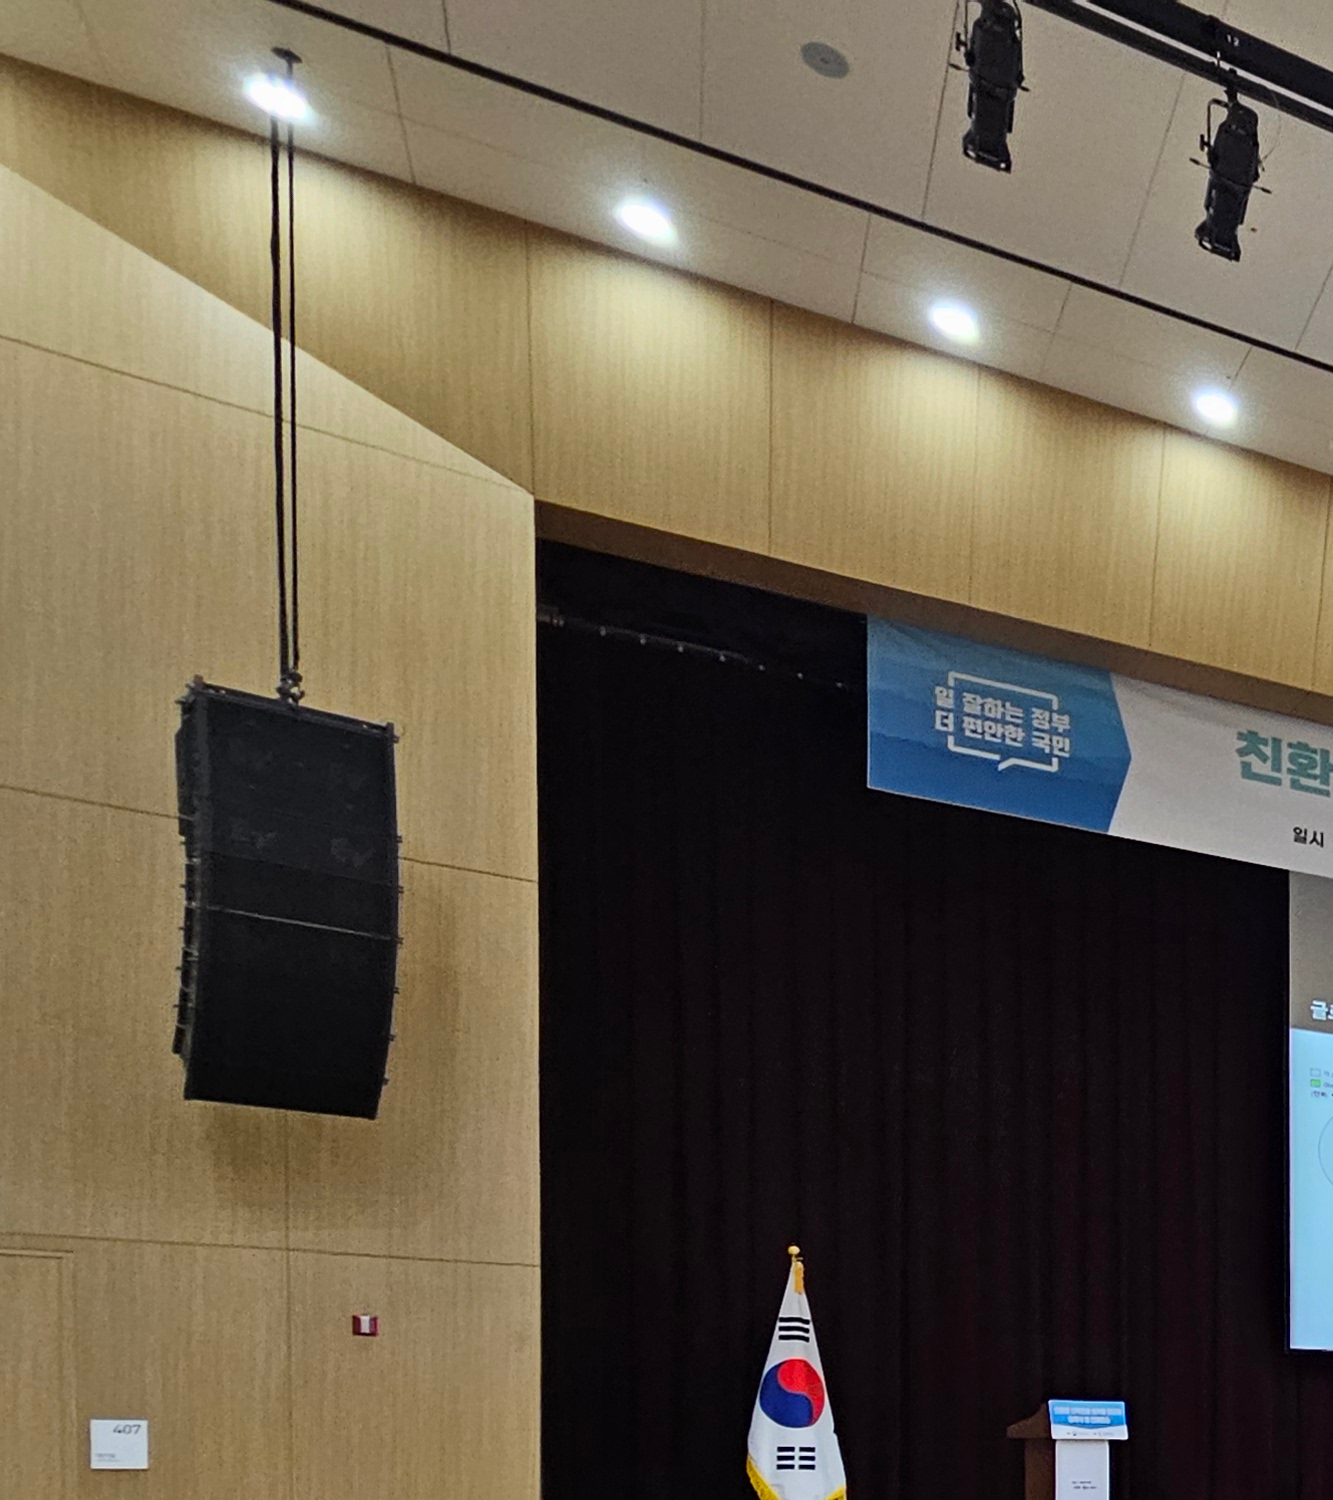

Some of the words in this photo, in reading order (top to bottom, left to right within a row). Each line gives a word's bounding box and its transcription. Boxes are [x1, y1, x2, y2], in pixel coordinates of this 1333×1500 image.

[935, 686, 954, 708] 일
[962, 692, 1024, 723] 잘하는
[1031, 707, 1070, 733] 정부
[935, 710, 954, 732] 더
[962, 716, 1025, 747] 편안한
[1032, 731, 1070, 758] 국민
[1293, 826, 1325, 848] 일시
